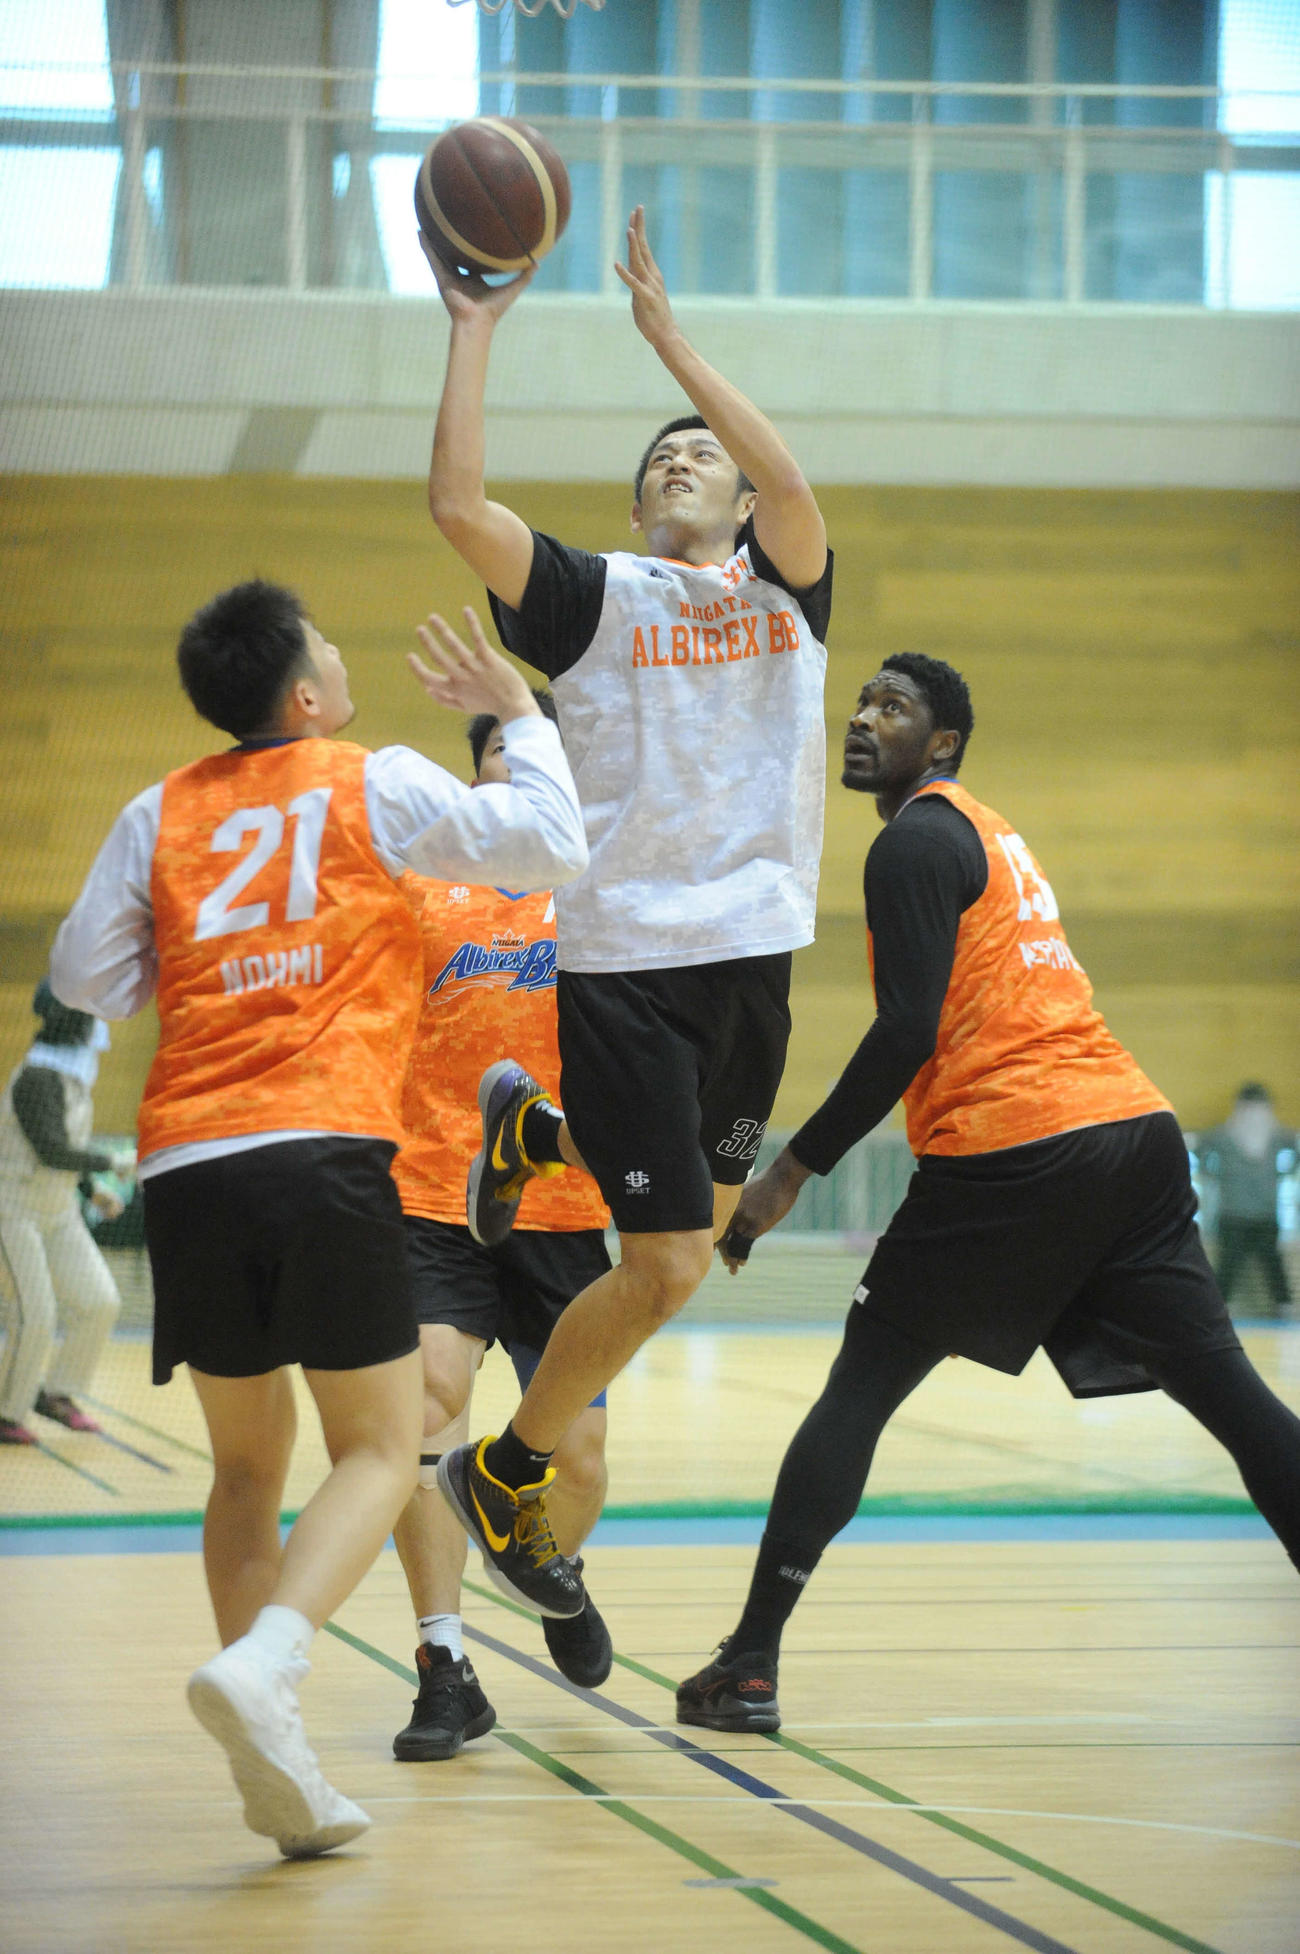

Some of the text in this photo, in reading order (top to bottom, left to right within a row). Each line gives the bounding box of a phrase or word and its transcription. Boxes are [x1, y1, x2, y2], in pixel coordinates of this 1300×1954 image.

[679, 596, 752, 621] NIIGATA
[632, 611, 800, 667] ALBIREX BB
[194, 787, 334, 942] 21
[219, 943, 324, 997] NOHMI
